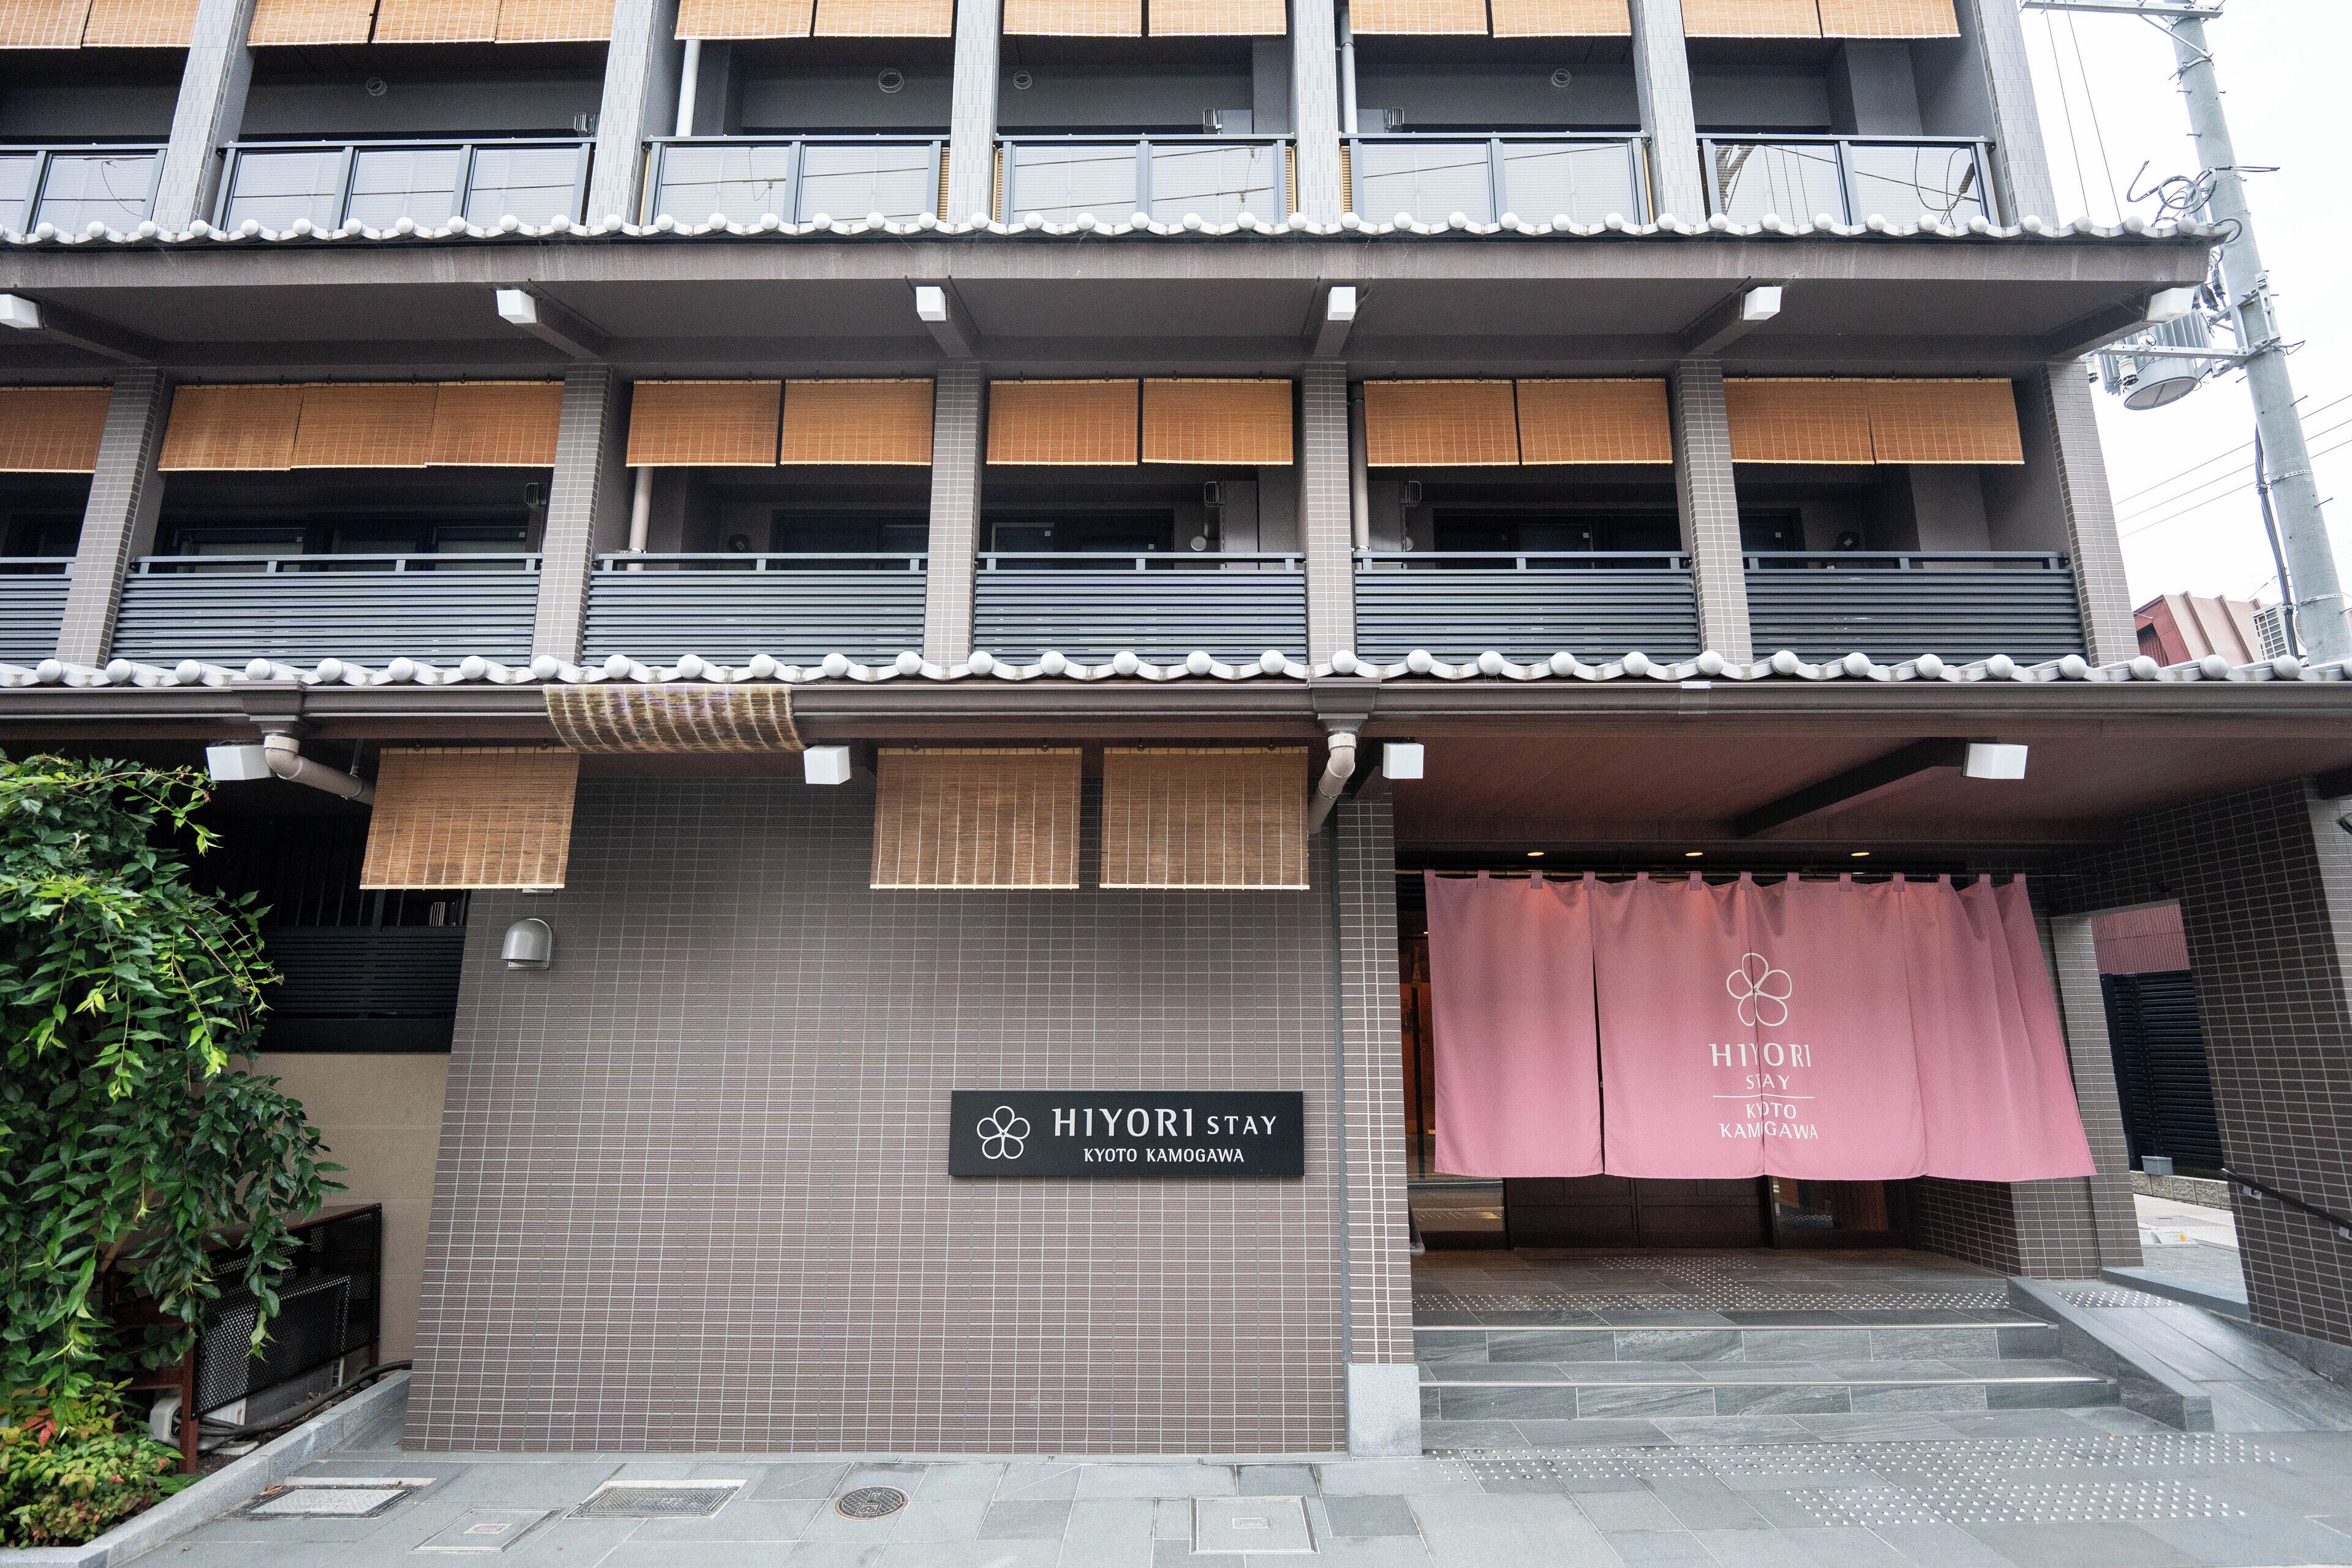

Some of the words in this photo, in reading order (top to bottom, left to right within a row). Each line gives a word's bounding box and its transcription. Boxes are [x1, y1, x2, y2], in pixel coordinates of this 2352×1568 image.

[1709, 1042, 1811, 1068] HIYORI
[1746, 1073, 1790, 1090] STAY
[1052, 1108, 1192, 1137] HIYORI
[1207, 1115, 1276, 1135] STAY
[1084, 1148, 1137, 1163] KYOTO
[1146, 1148, 1245, 1163] KAMOGAWA
